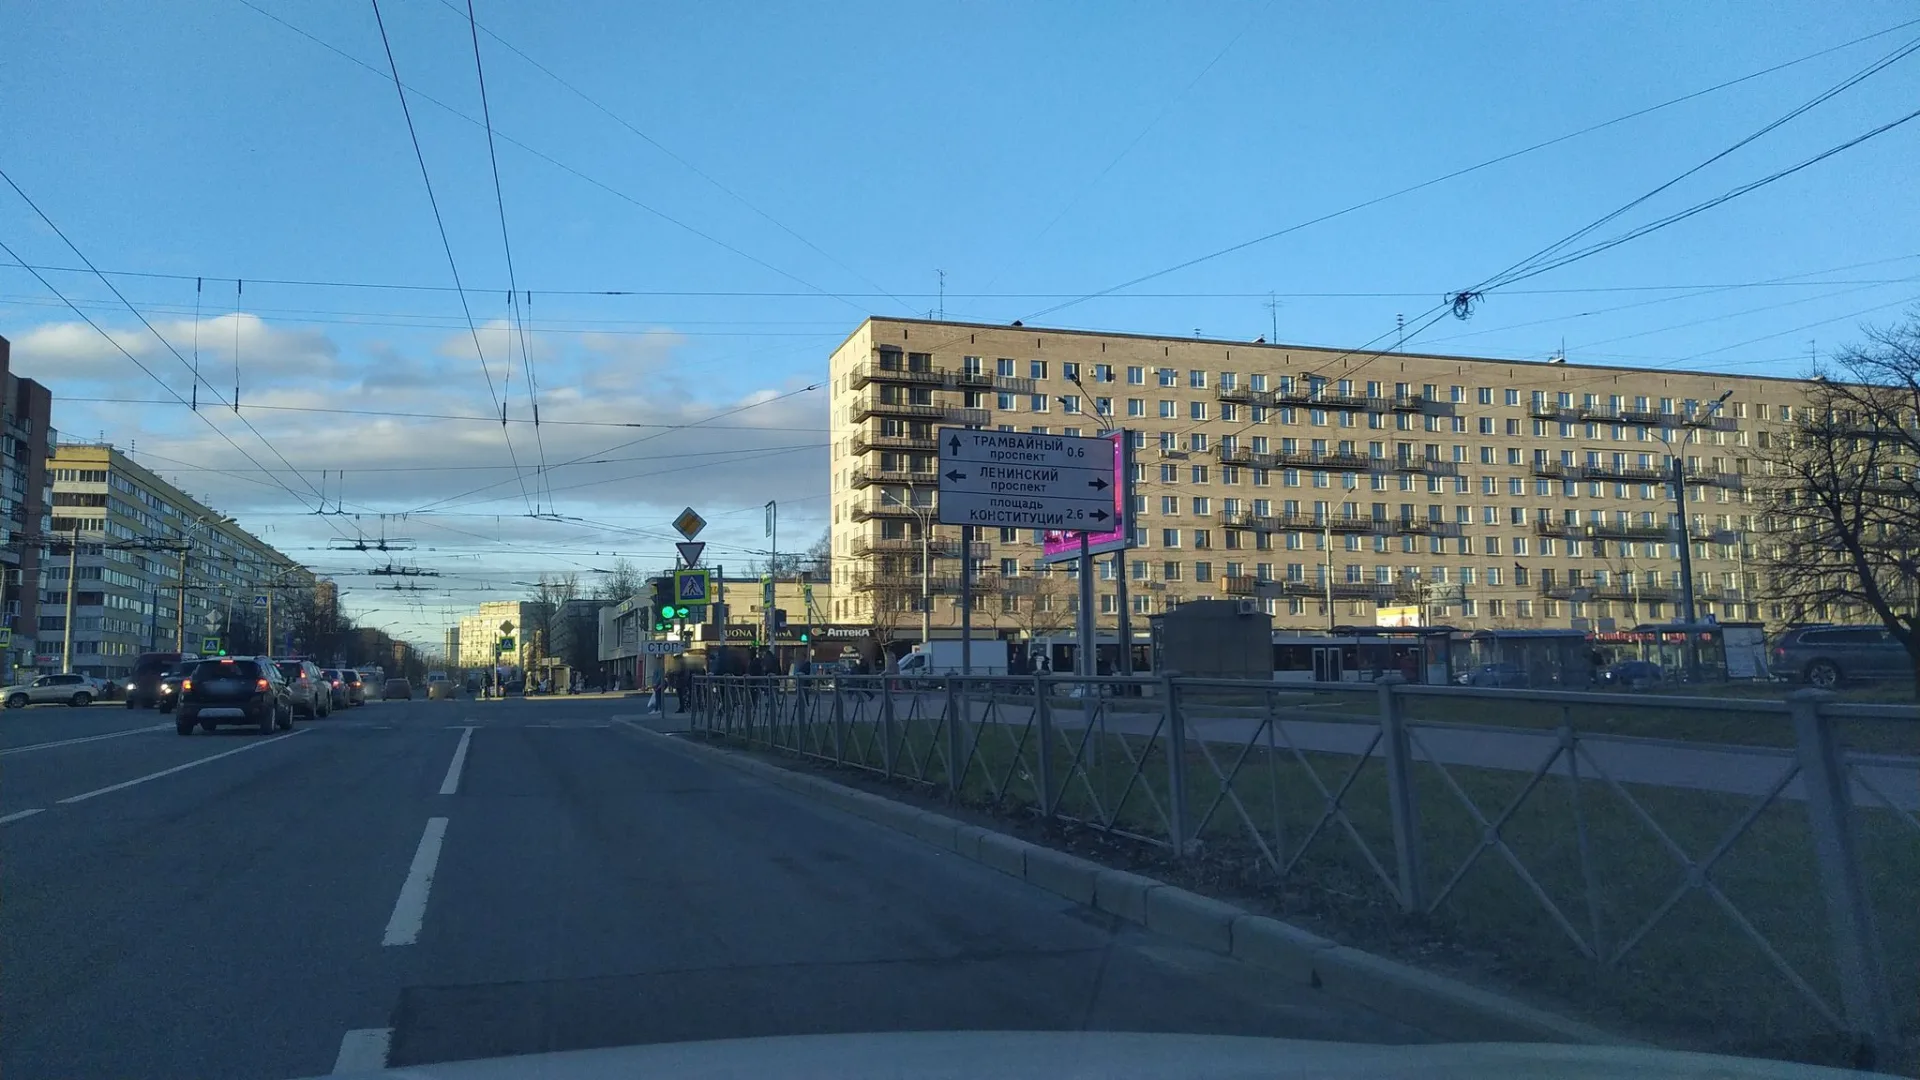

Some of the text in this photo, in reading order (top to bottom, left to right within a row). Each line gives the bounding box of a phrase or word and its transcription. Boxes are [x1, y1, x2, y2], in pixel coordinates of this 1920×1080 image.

[973, 435, 1085, 458] ТРАМВАЙНЫЙ 0.6
[990, 450, 1046, 461] проспект
[980, 466, 1059, 482] ЛЕНИНСКИЙ
[990, 482, 1046, 492] проспект
[990, 499, 1043, 510] площадь
[970, 508, 1084, 525] КОНСТИТУЦИИ 2.6
[722, 629, 752, 637] UONA
[647, 642, 679, 652] СТОП
